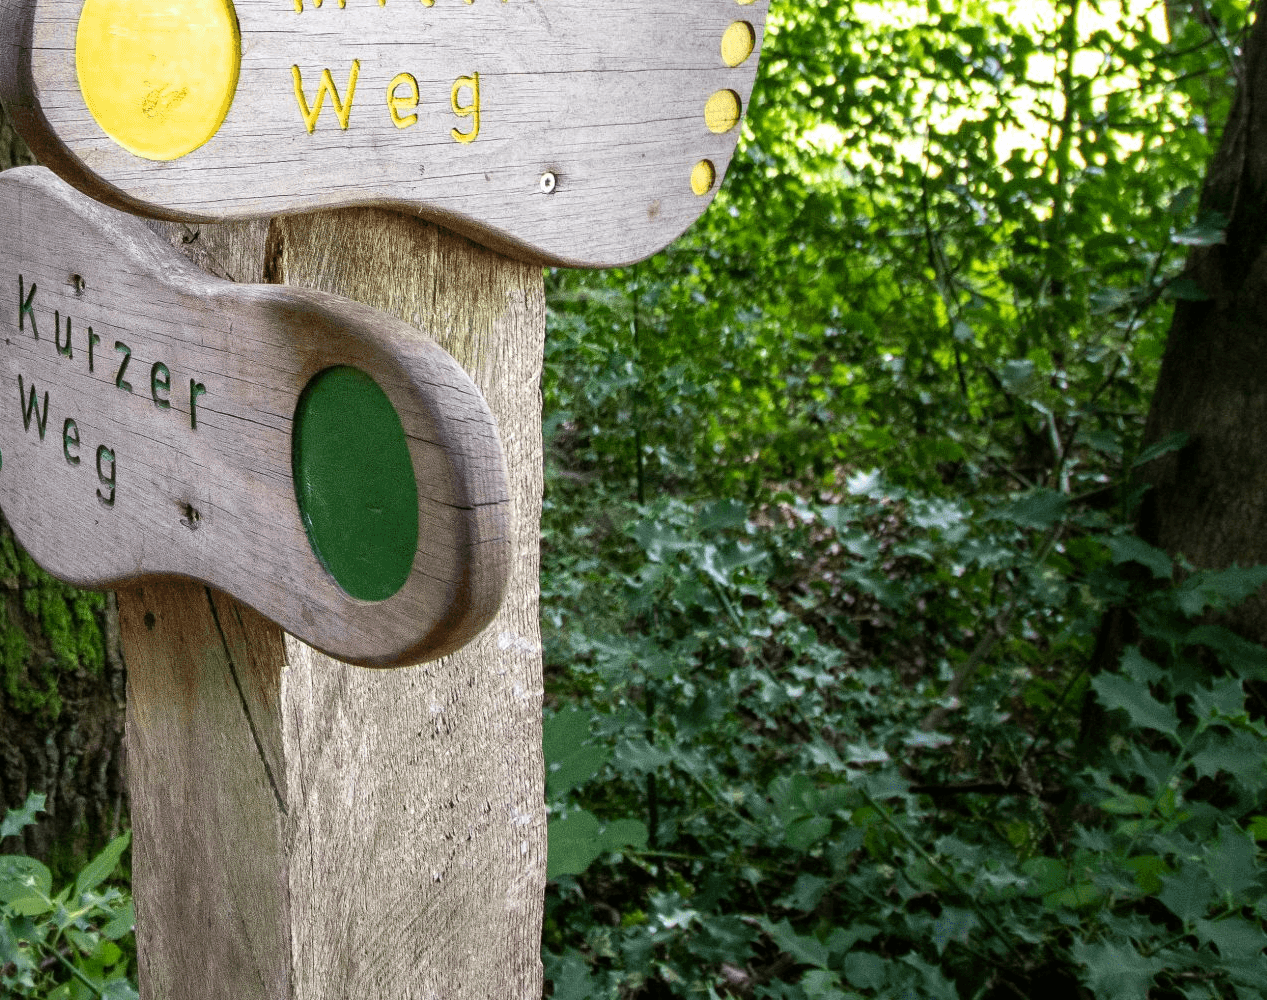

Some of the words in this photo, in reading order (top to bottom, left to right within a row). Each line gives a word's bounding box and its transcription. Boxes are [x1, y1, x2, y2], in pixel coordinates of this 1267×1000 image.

[291, 58, 481, 144] Weg
[18, 273, 207, 431] Kurzer
[18, 373, 117, 510] Weg
